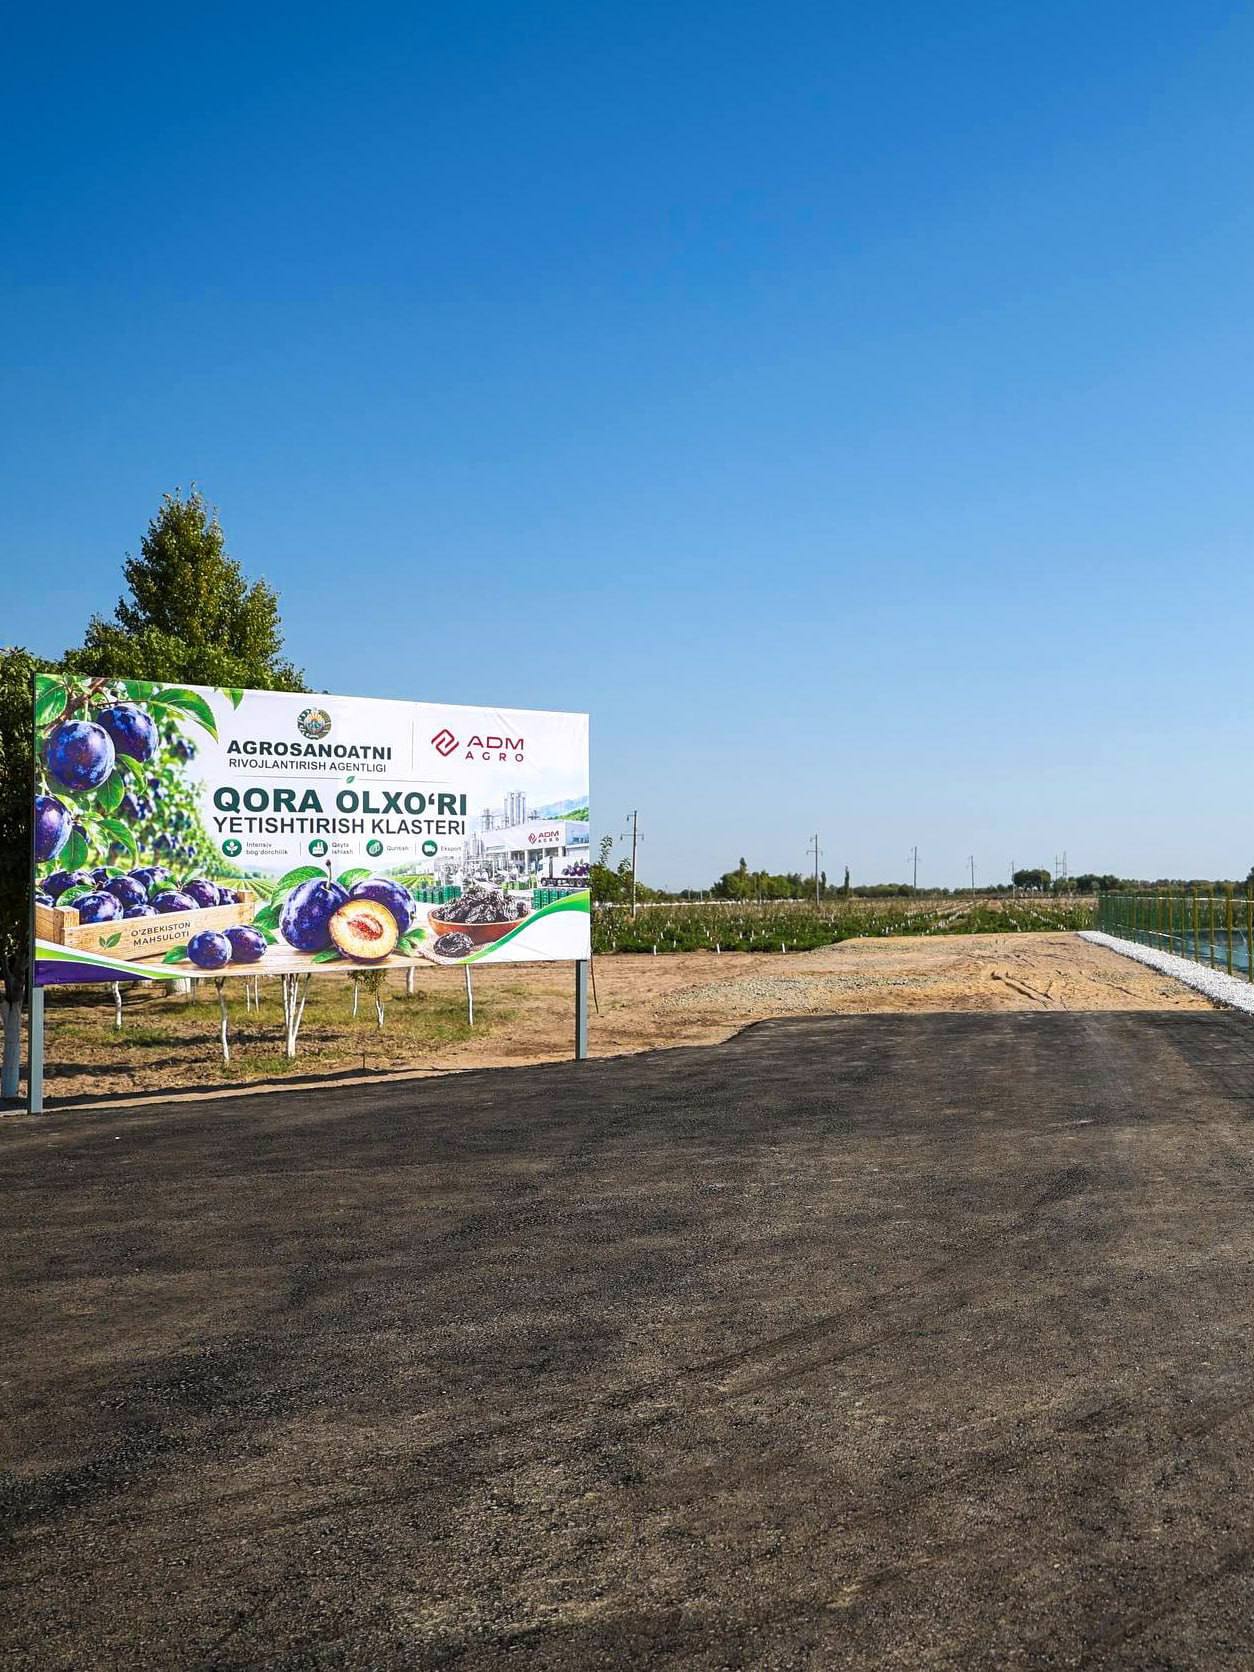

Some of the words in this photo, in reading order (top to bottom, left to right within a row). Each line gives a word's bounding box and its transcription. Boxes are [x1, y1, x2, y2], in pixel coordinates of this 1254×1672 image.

[227, 740, 392, 760] AGROSANOATNI
[467, 735, 524, 750] ADM
[465, 751, 524, 762] AGRO
[229, 758, 326, 770] RIVOJLANTIRISH
[329, 762, 387, 773] AGENTLIGI
[213, 787, 323, 815] QORA
[213, 816, 364, 834] YETISHTIRISH
[372, 818, 465, 835] KLASTERI
[538, 830, 560, 838] ADM
[133, 931, 190, 946] MAHSULOTI
